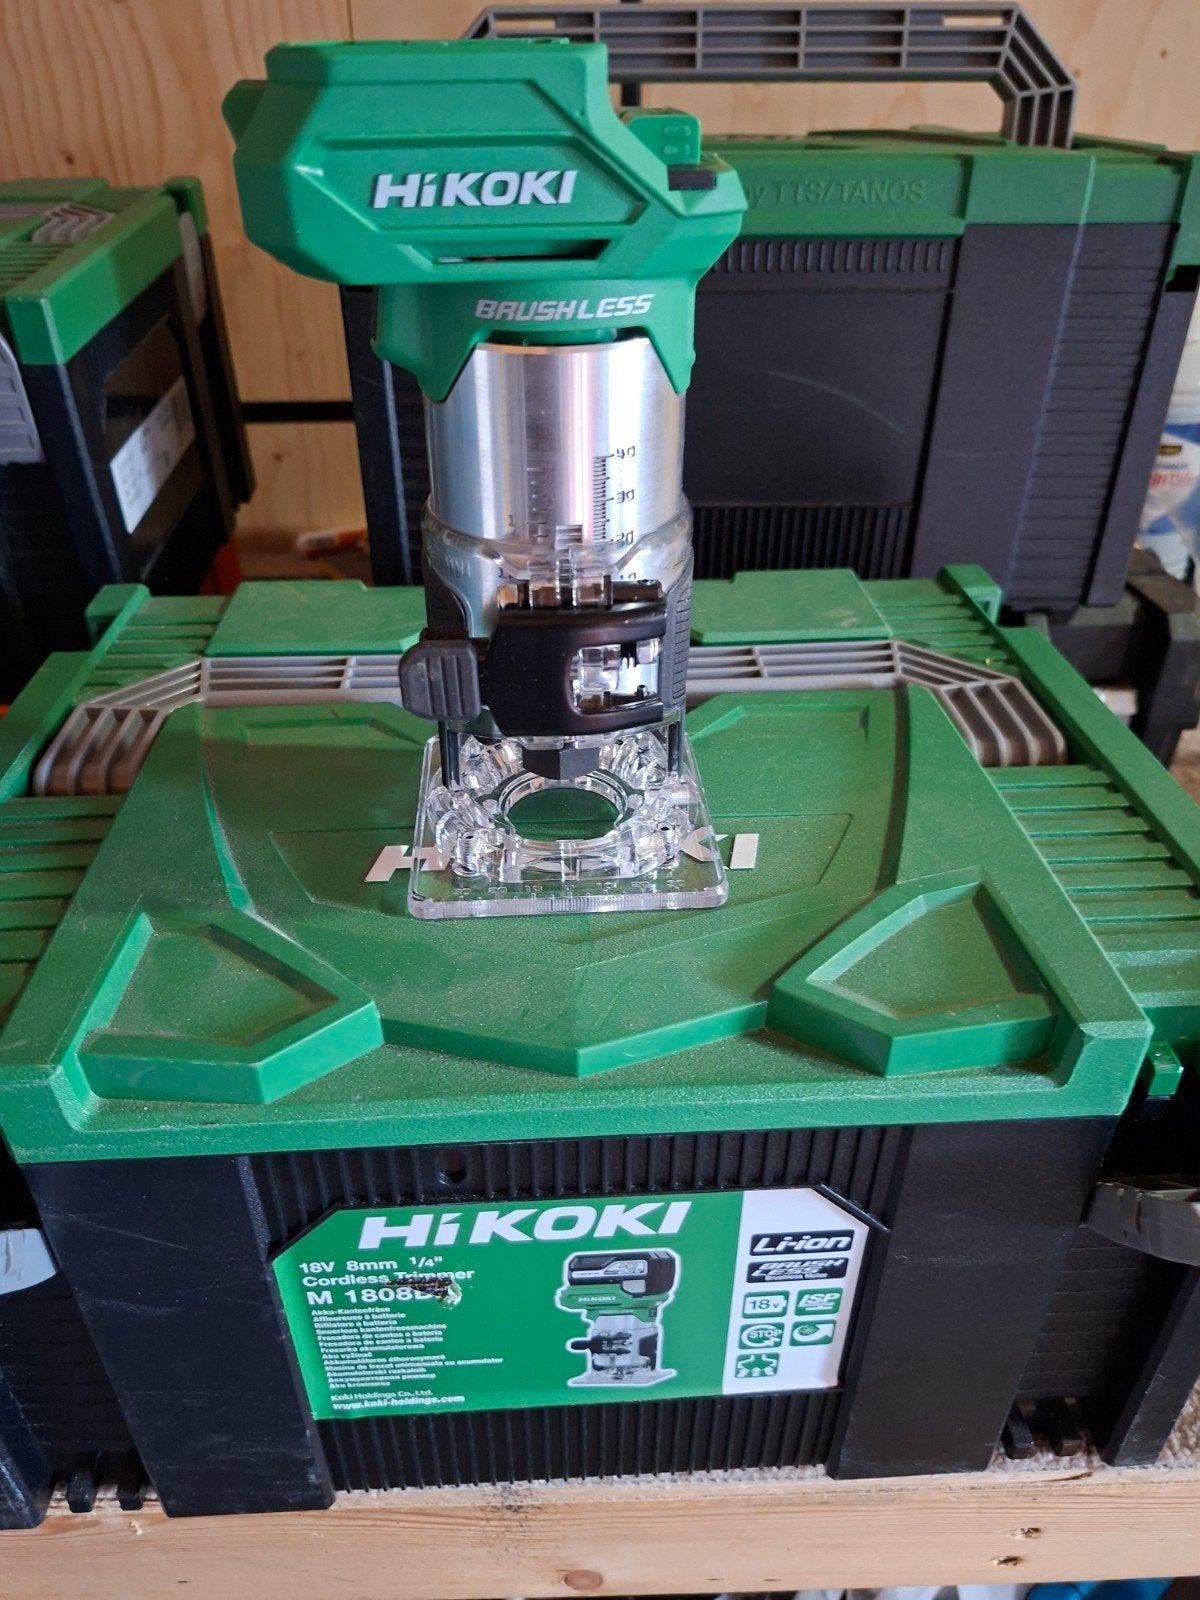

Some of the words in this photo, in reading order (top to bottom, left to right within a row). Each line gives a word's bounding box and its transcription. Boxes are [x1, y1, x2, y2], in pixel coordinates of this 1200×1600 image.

[372, 171, 578, 209] HiKOKI
[770, 179, 926, 204] TTS/TANOS
[475, 294, 655, 321] BRUSHLESS
[357, 1201, 692, 1249] HiKOKI
[299, 1261, 335, 1274] 18V
[346, 1260, 398, 1271] 8mm
[302, 1275, 389, 1287] Cordless
[306, 1290, 334, 1305] M
[331, 1393, 353, 1401] Koki
[354, 1389, 396, 1400] Holdings
[332, 1396, 465, 1410] www.koki-holdings.com
